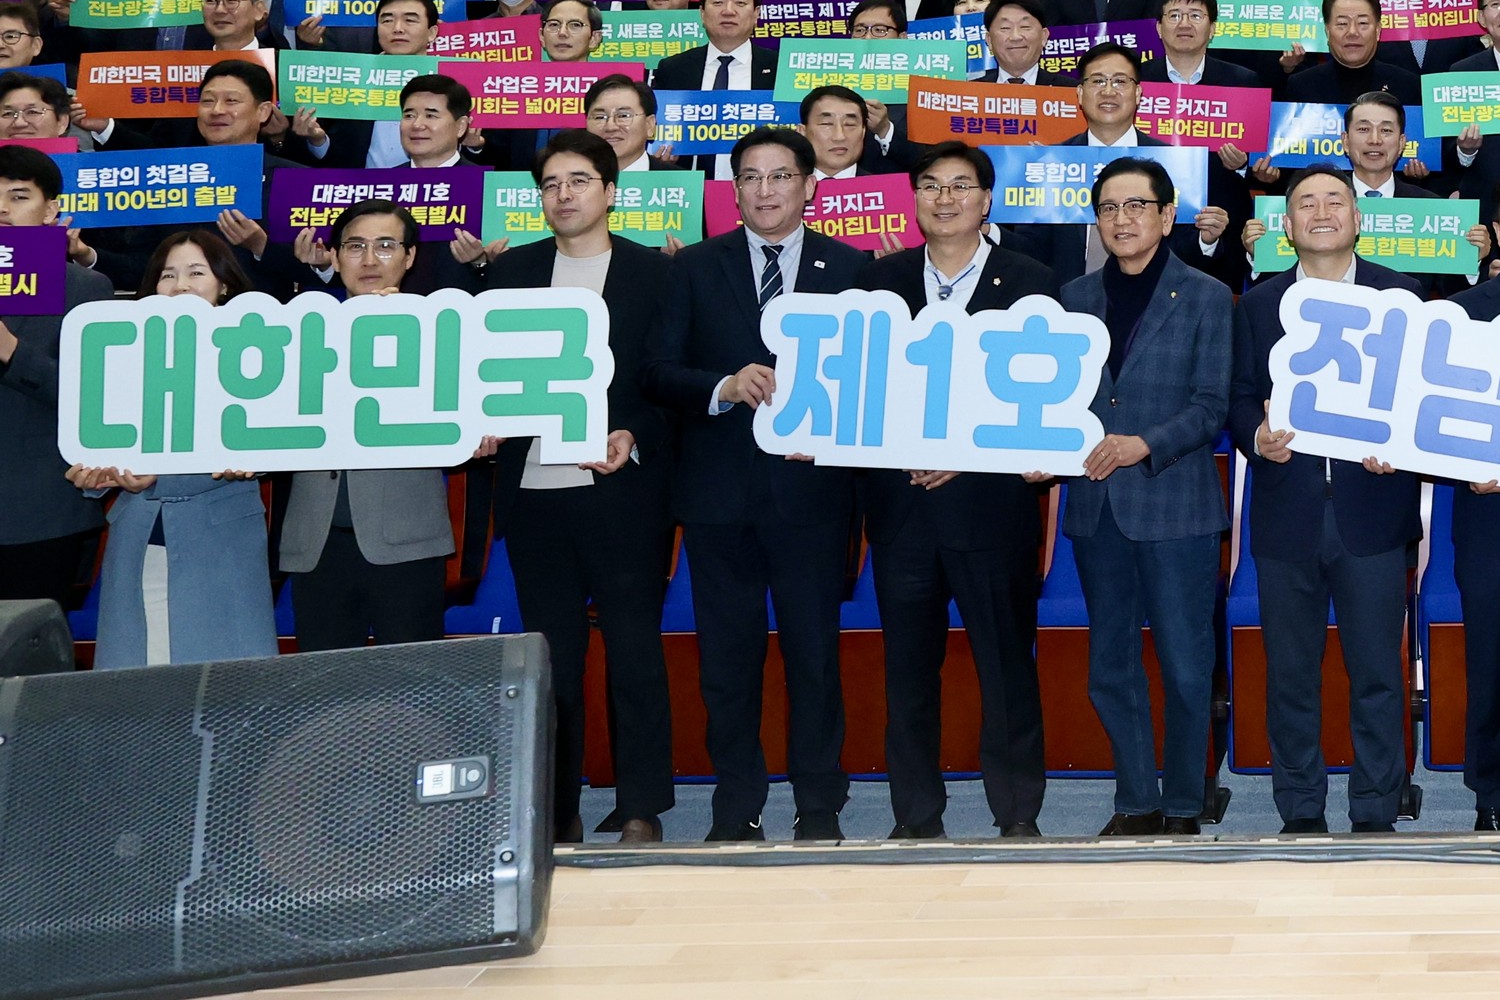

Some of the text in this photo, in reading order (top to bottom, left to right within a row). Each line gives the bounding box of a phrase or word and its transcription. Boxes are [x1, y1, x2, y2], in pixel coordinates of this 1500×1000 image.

[788, 52, 955, 71] 대한민국 새로운 시작,
[289, 65, 360, 83] 대한민국
[483, 75, 598, 93] 산업은 커지고
[917, 91, 1077, 117] 대한민국 미래를 여는
[1434, 85, 1500, 103] 대한민국
[664, 103, 779, 121] 통합의 첫걸음,
[1178, 100, 1226, 117] 커지고
[950, 116, 1037, 134] 통합특별시
[1158, 116, 1244, 139] 넓어집니다
[77, 164, 216, 187] 통합의 첫걸음,
[1025, 162, 1086, 182] 통합의
[59, 184, 236, 214] 미래 100년의 출발
[312, 182, 391, 202] 대한민국
[1421, 214, 1466, 235] 시작,
[78, 308, 595, 455] 대한민국
[773, 308, 1092, 451] 제1호
